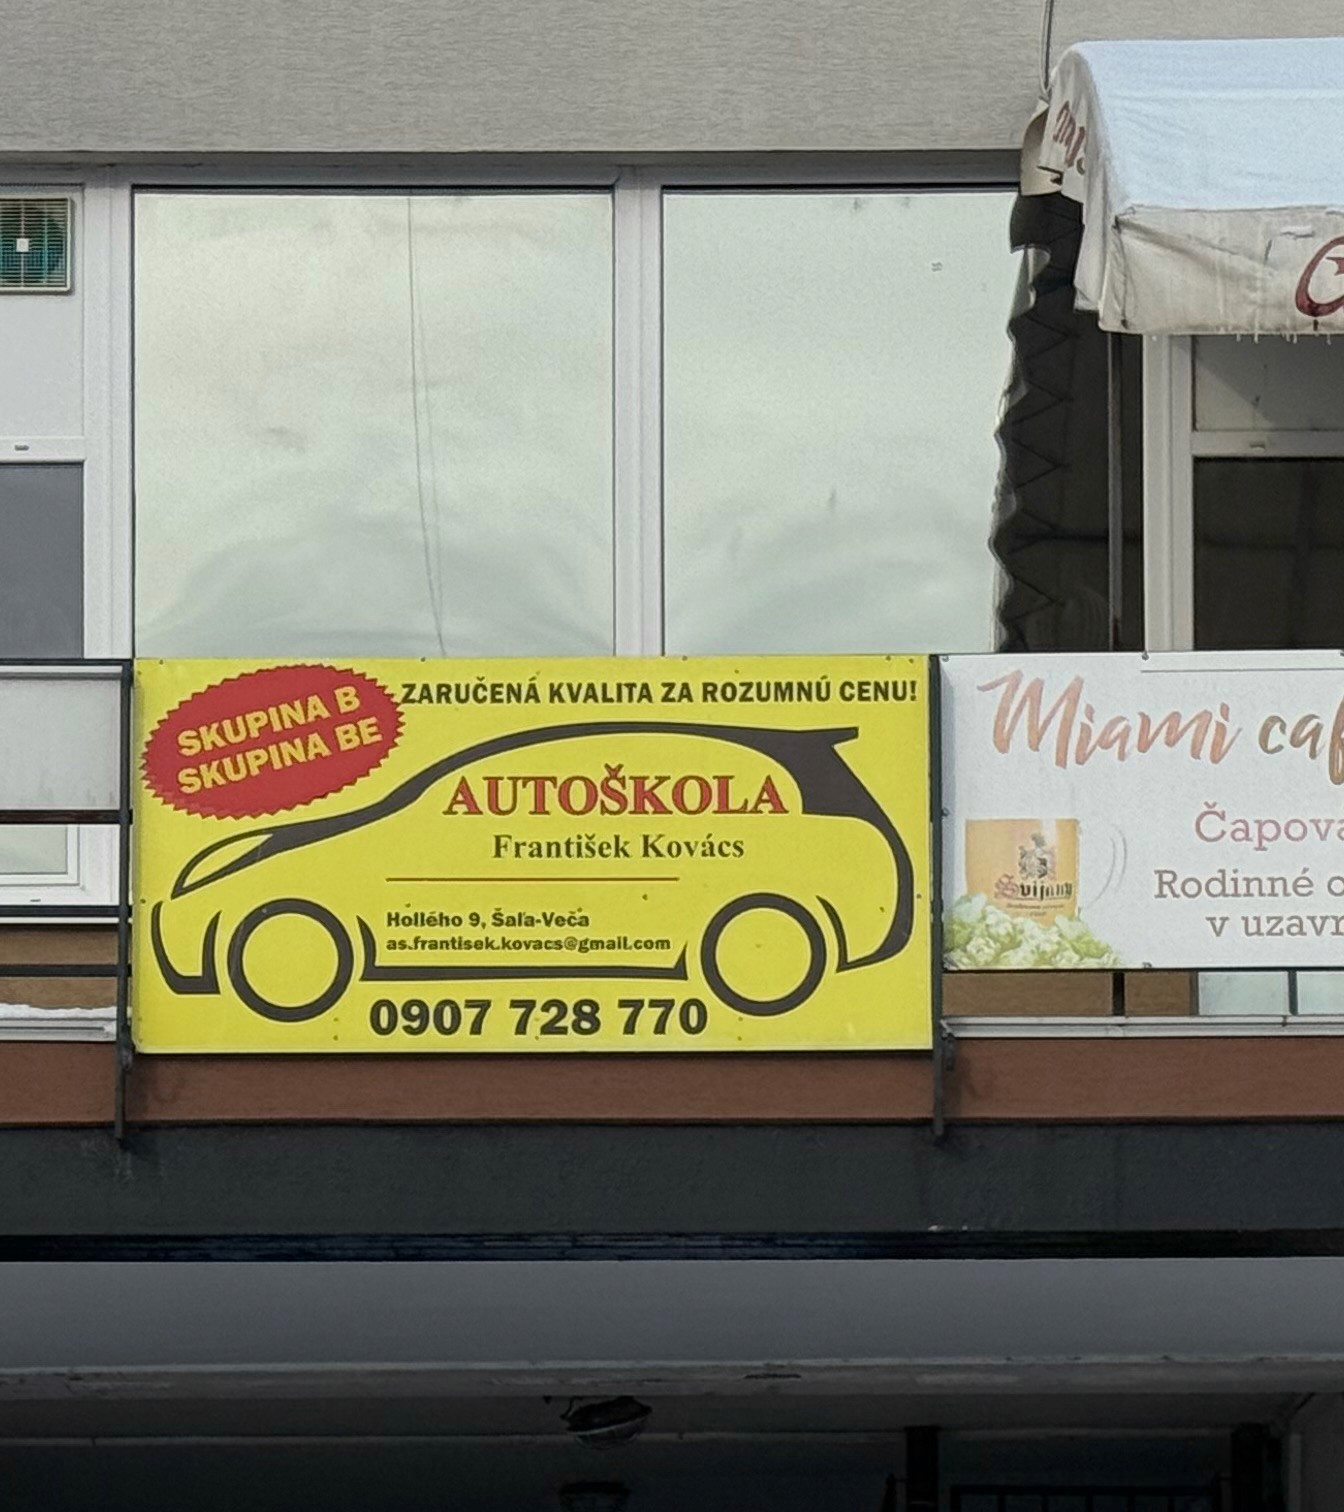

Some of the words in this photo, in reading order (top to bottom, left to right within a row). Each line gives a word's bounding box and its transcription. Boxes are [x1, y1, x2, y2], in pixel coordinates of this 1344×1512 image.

[401, 676, 541, 704] ZARUČENÁ
[549, 681, 654, 703] KVALITA
[661, 681, 695, 703] ZA
[702, 675, 832, 703] ROZUMNÚ
[839, 679, 918, 702] CENU!
[178, 693, 330, 757] SKUPINA
[334, 685, 361, 714] B
[977, 669, 1243, 769] Miami
[178, 731, 332, 795] SKUPINA
[335, 716, 383, 752] BE
[443, 762, 789, 816] AUTOŠKOLA
[493, 833, 632, 860] František
[641, 833, 745, 860] Kovács
[1154, 867, 1314, 898] Rodinné
[387, 911, 463, 928] Hollého
[468, 912, 487, 930] 9,
[1206, 916, 1230, 937] v
[386, 935, 671, 953] as.frantisek.kovacs@gmail.com
[370, 998, 492, 1036] 0907
[509, 998, 601, 1036] 728
[617, 998, 708, 1036] 770
